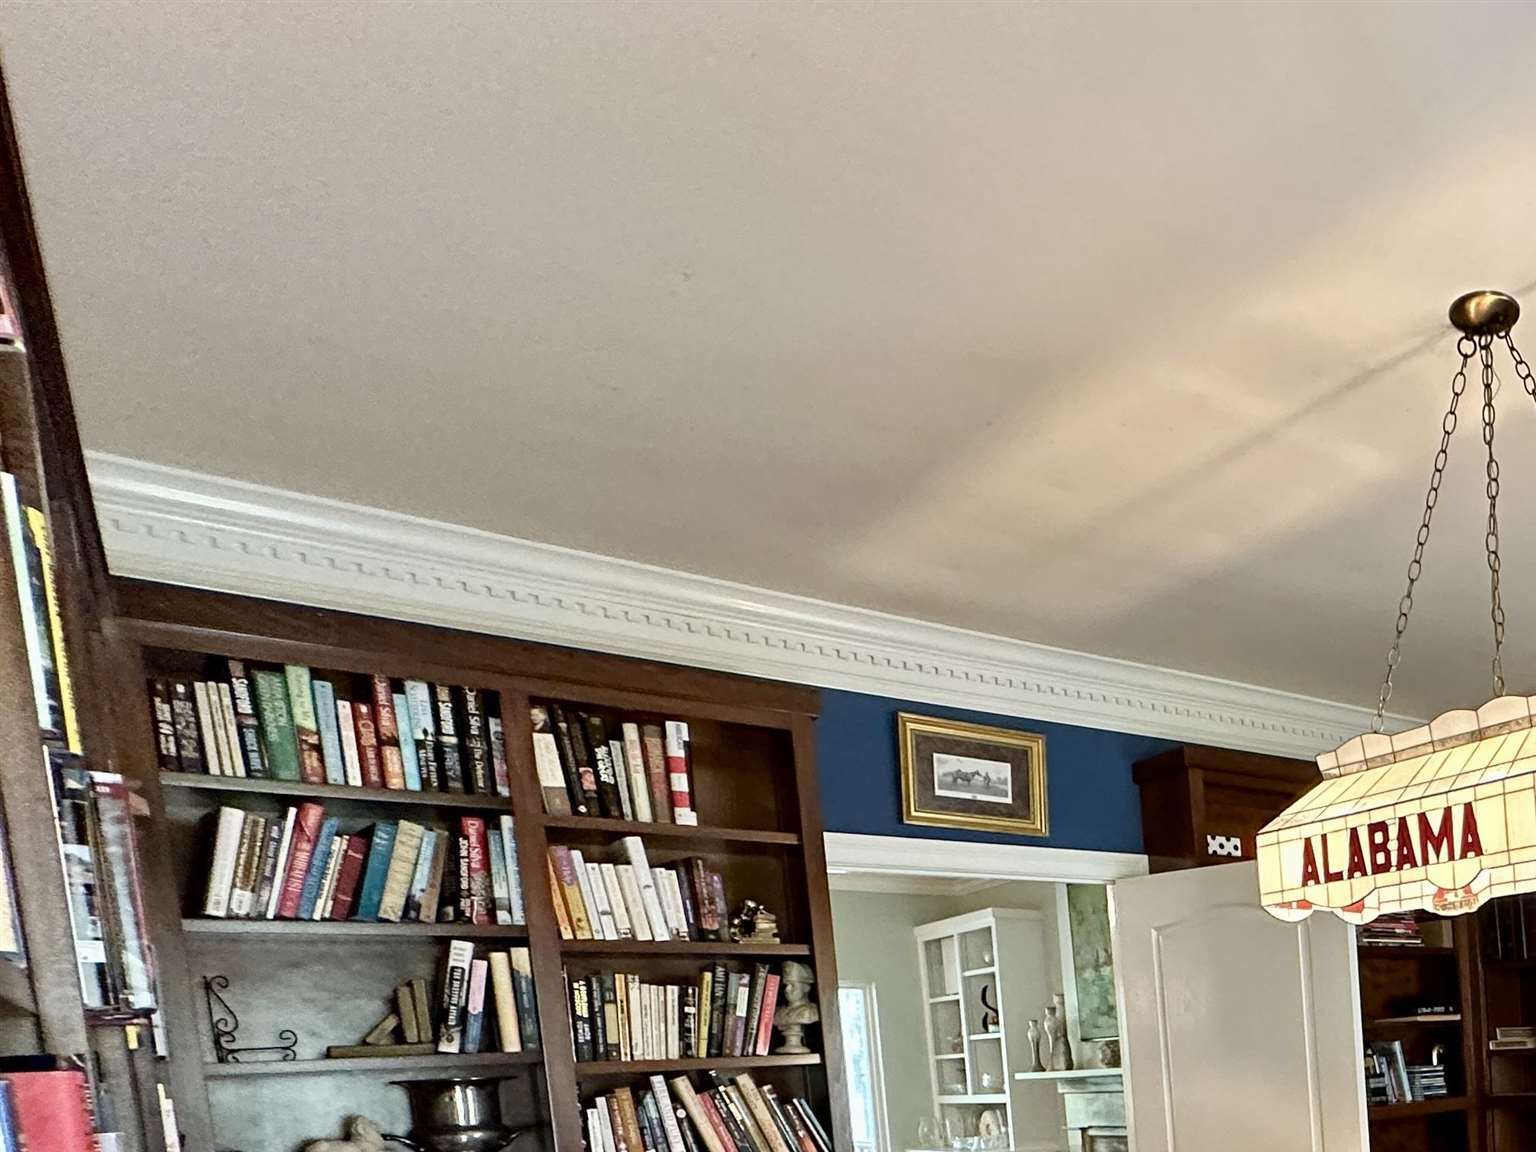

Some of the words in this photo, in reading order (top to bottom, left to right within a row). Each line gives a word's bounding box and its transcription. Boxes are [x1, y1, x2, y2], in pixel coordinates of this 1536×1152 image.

[463, 686, 480, 715] Daniel
[468, 715, 482, 736] Silva
[1301, 801, 1486, 889] ALABAMA
